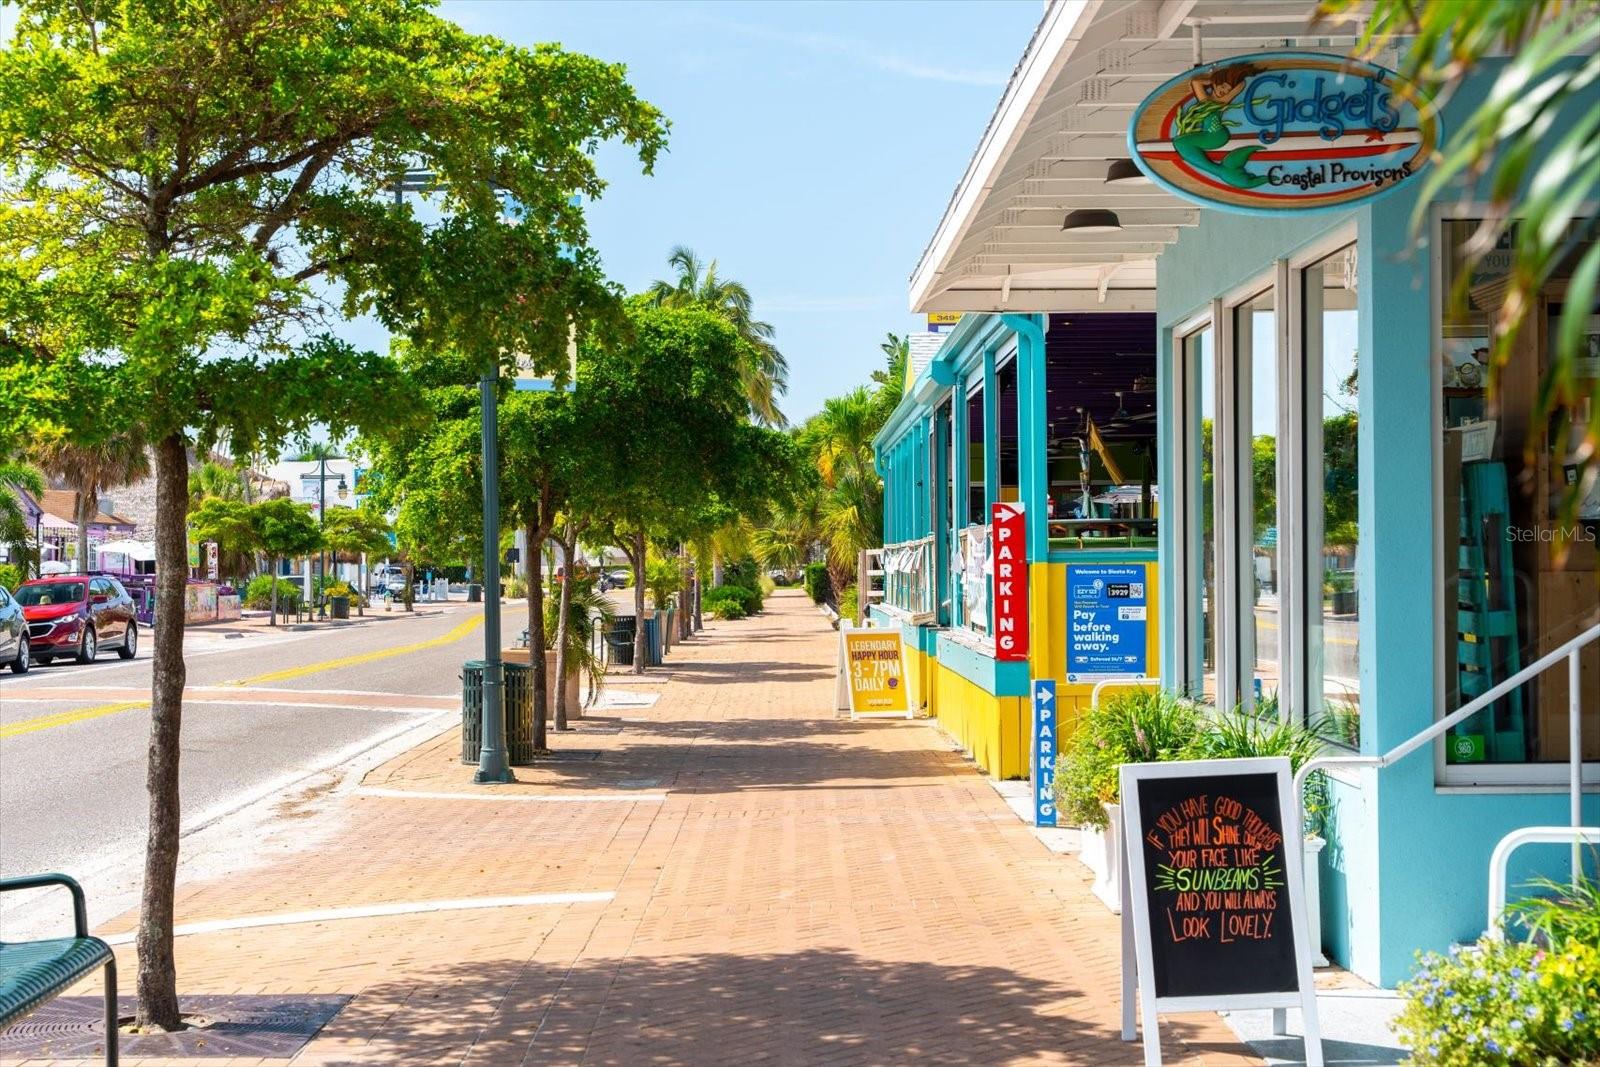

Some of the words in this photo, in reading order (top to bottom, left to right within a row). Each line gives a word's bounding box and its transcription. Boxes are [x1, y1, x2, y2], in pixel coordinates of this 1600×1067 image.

[1244, 68, 1400, 144] Gidget's
[1268, 164, 1326, 190] Coastal
[998, 527, 1014, 650] PARKING
[1073, 610, 1096, 621] Pay
[1073, 622, 1112, 632] before
[850, 640, 898, 650] LEGENDARY
[1073, 632, 1120, 644] walking
[1073, 643, 1110, 653] away.
[852, 650, 876, 661] HAPPY
[878, 650, 899, 660] HOUR
[854, 660, 862, 678] 3
[870, 660, 901, 677] 7PM
[854, 677, 885, 691] DAILY
[1040, 709, 1052, 817] PARKING
[1146, 830, 1164, 850] IF
[1156, 808, 1182, 834] YOU
[1180, 794, 1209, 820] HAVE
[1214, 796, 1243, 820] GOOD
[1170, 821, 1190, 848] THEY
[1192, 818, 1210, 846] WILL
[1213, 816, 1240, 845] SHINE
[1168, 850, 1198, 868] YOUR
[1202, 848, 1228, 867] FACE
[1234, 848, 1260, 867] LIKE
[1176, 868, 1260, 891] SUNBEAMS
[1176, 892, 1200, 911] AND
[1202, 891, 1221, 910] YOU
[1224, 892, 1241, 910] WILL
[1243, 890, 1277, 910] ALWAYS
[1167, 907, 1210, 942] LOOK
